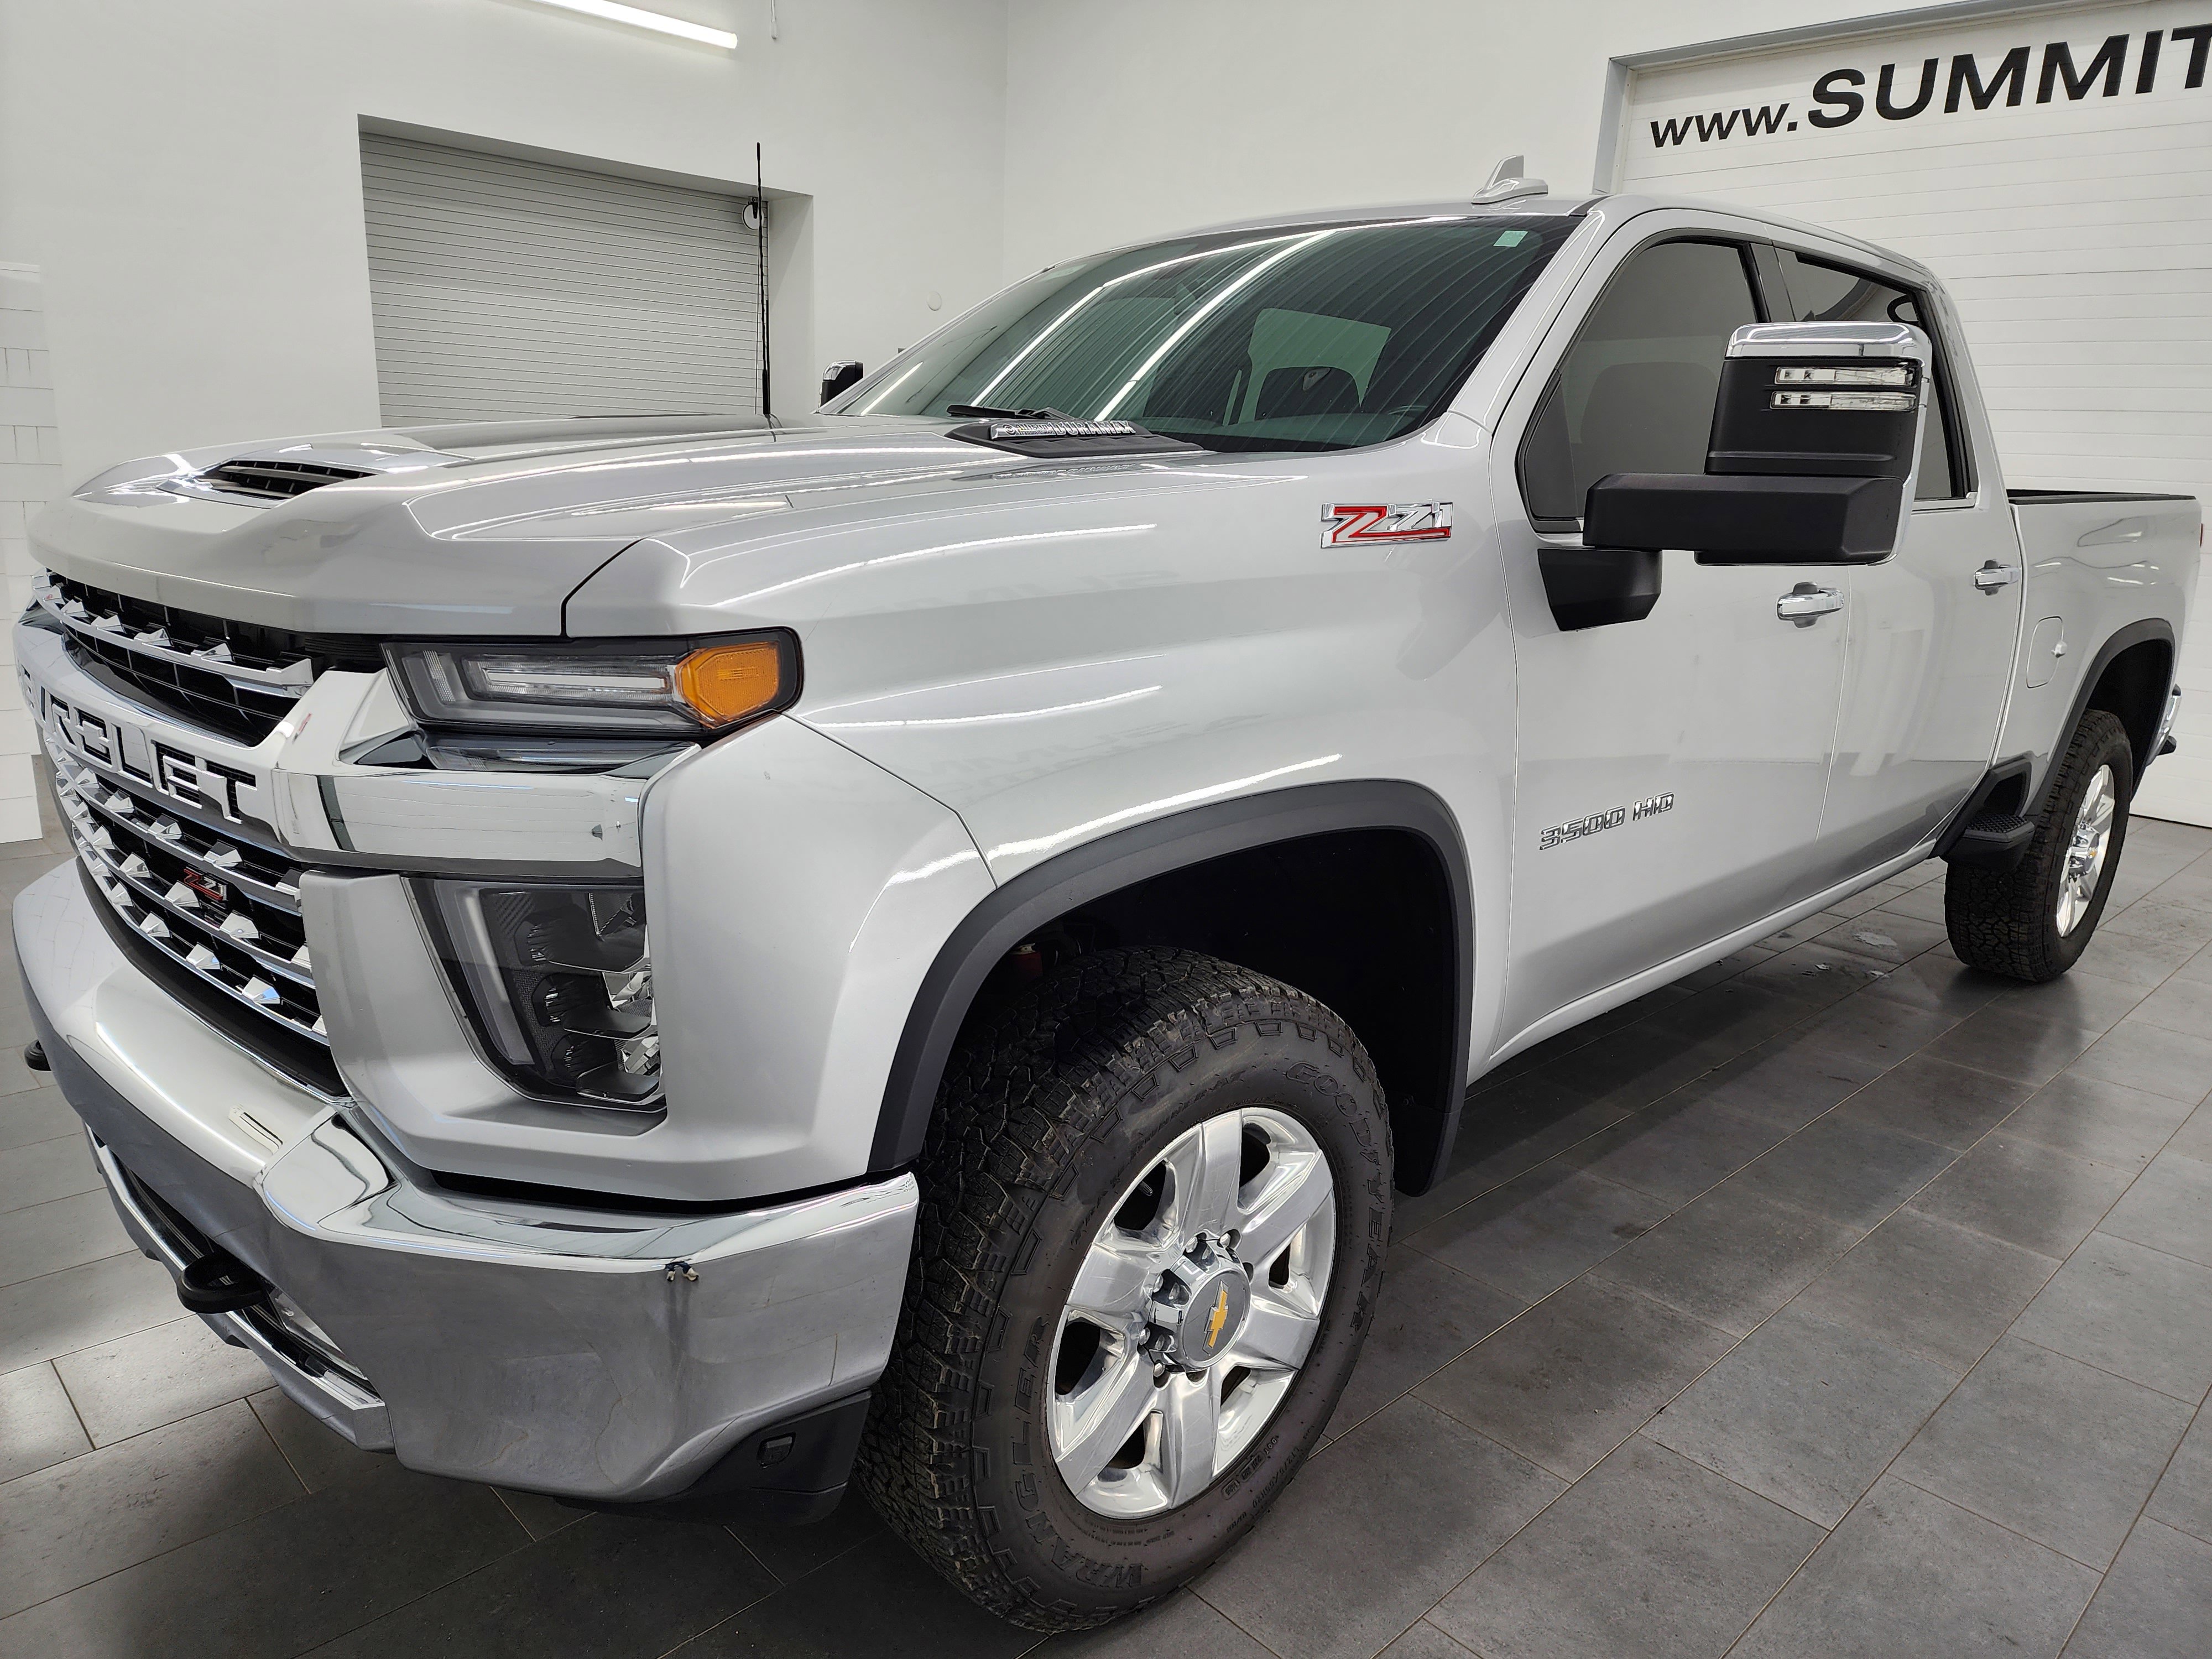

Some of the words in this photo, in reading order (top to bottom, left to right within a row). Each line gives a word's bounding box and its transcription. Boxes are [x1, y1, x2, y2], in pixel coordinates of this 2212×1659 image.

[1050, 420, 1136, 436] DURAMAX
[1319, 500, 1453, 549] Z71
[1540, 806, 1626, 851] 3500
[1632, 791, 1674, 822] HD
[1285, 1061, 1384, 1332] GOODYEAR
[1013, 1315, 1144, 1588] WRANGLER
